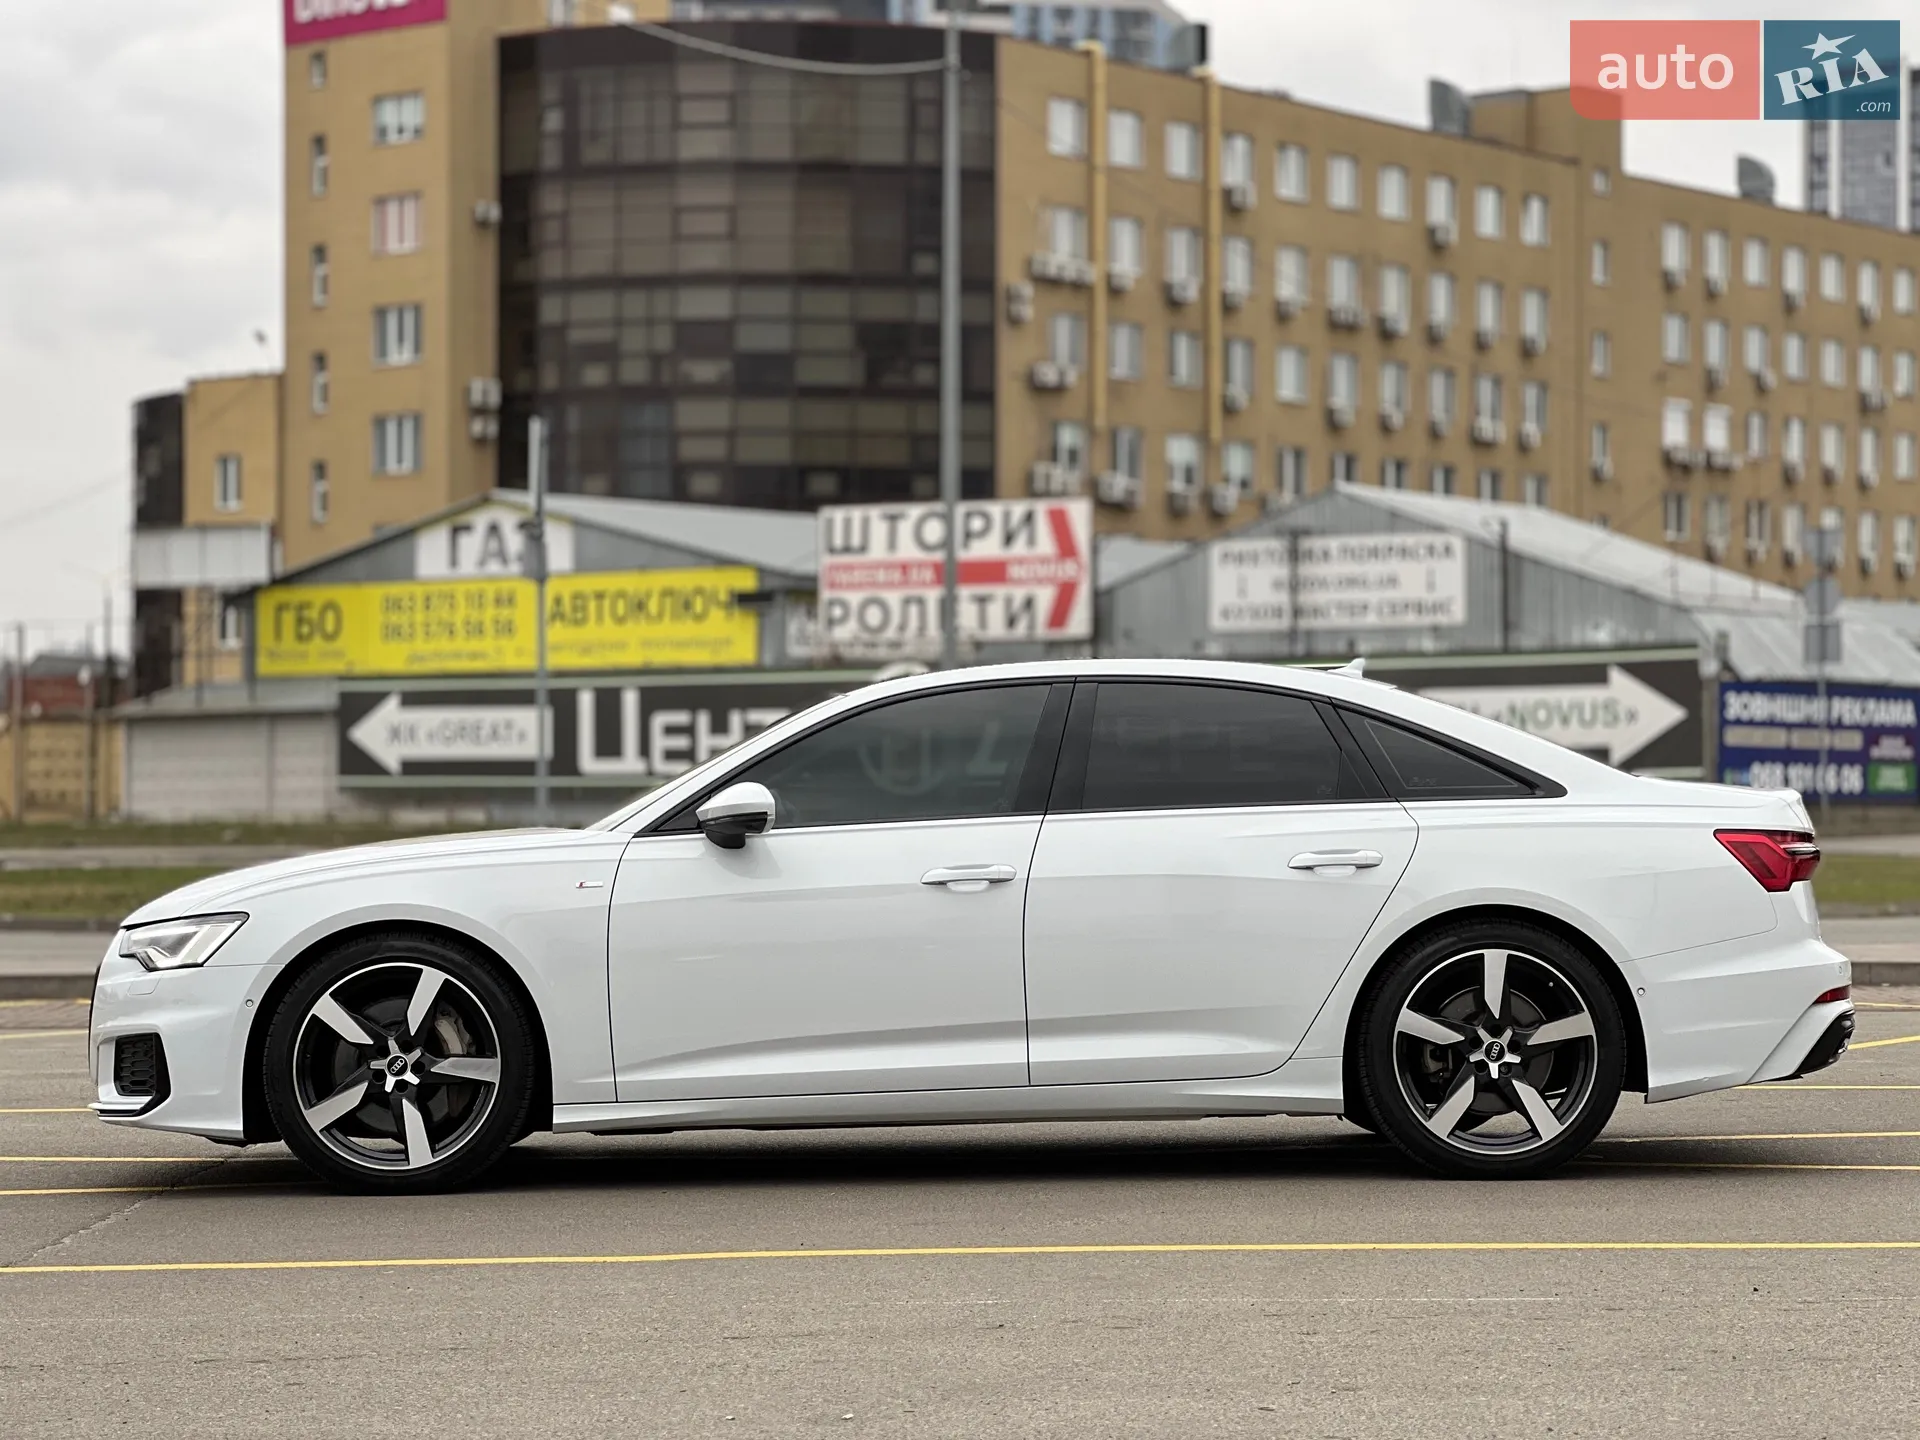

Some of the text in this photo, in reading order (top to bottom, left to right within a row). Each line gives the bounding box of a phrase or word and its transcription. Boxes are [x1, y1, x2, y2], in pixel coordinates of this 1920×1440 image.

[824, 507, 1037, 555] ШТОРИ
[1219, 545, 1330, 568] РИХТОКА
[272, 599, 344, 643] ГБО
[547, 586, 739, 628] АВТОКЛЮЧ
[1831, 695, 1917, 728] РЕКЛАМА
[385, 718, 421, 747] ЖК
